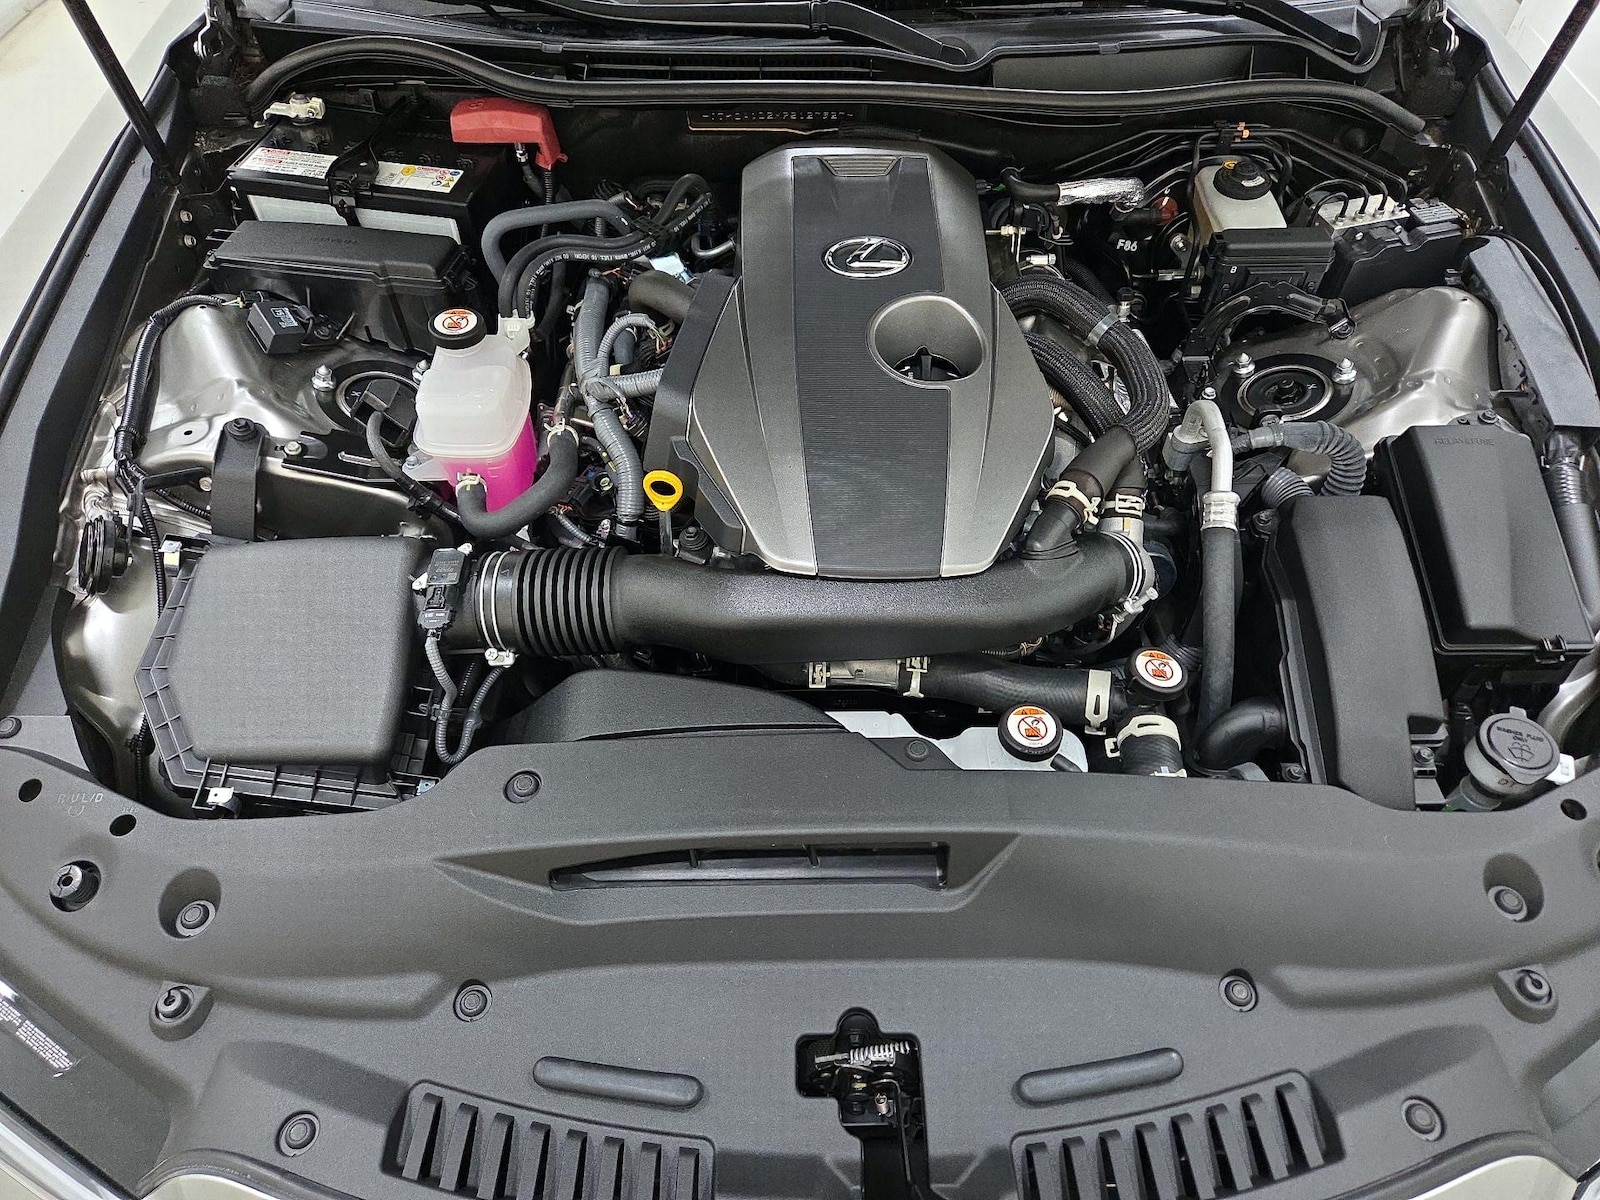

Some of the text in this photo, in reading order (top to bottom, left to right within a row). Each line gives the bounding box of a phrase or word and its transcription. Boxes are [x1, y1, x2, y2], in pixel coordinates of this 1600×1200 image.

[1116, 239, 1138, 251] F86
[1497, 726, 1544, 742] WASHER FLUID
